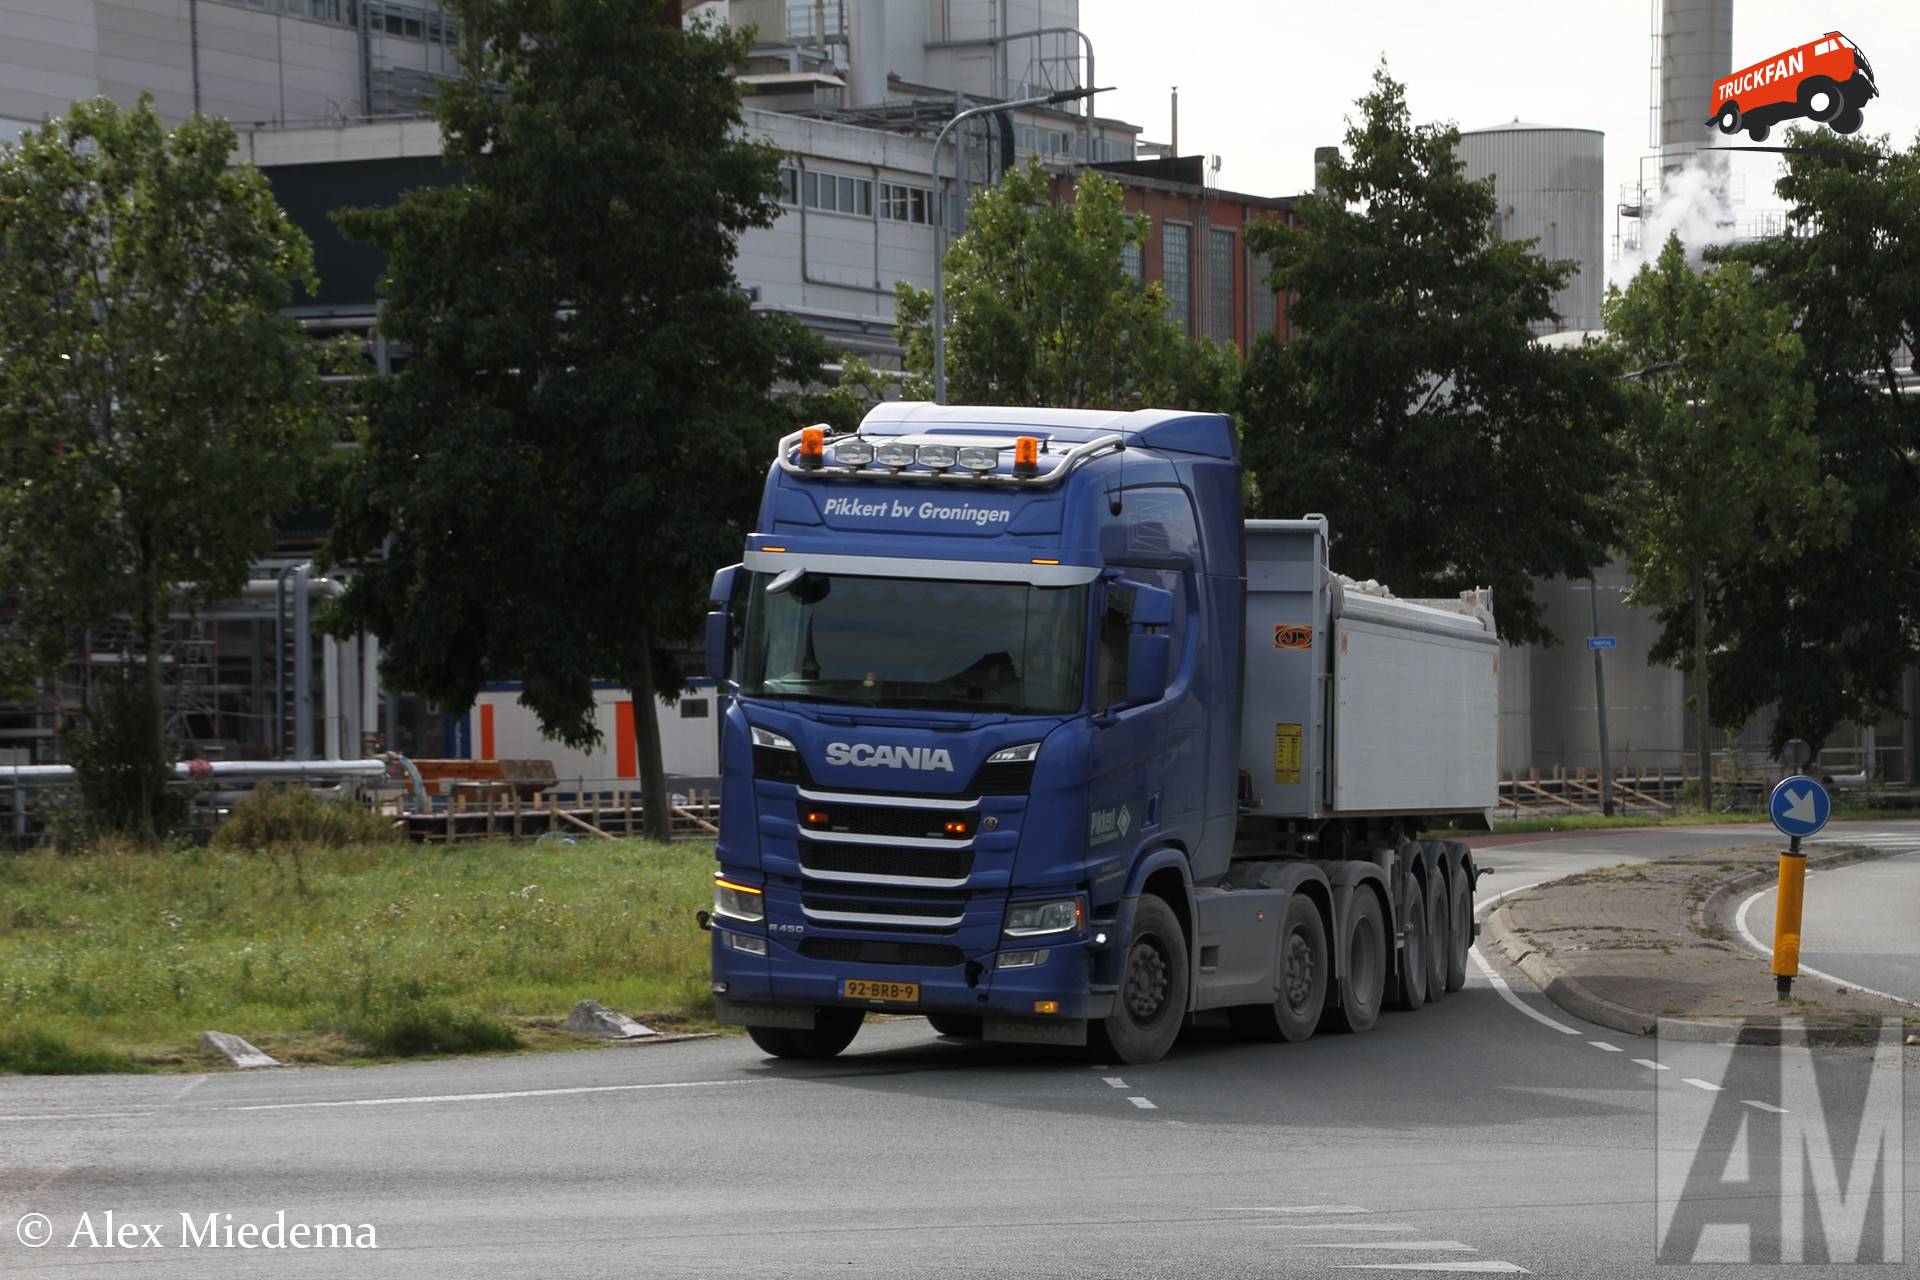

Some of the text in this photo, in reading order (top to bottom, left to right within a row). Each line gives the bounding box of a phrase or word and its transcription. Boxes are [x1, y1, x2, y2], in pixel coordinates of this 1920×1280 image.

[824, 498, 1010, 526] Pikkert bv Groningen
[825, 742, 954, 772] SCANIA
[768, 923, 804, 933] R 450
[848, 981, 914, 998] 92-BRB-9
